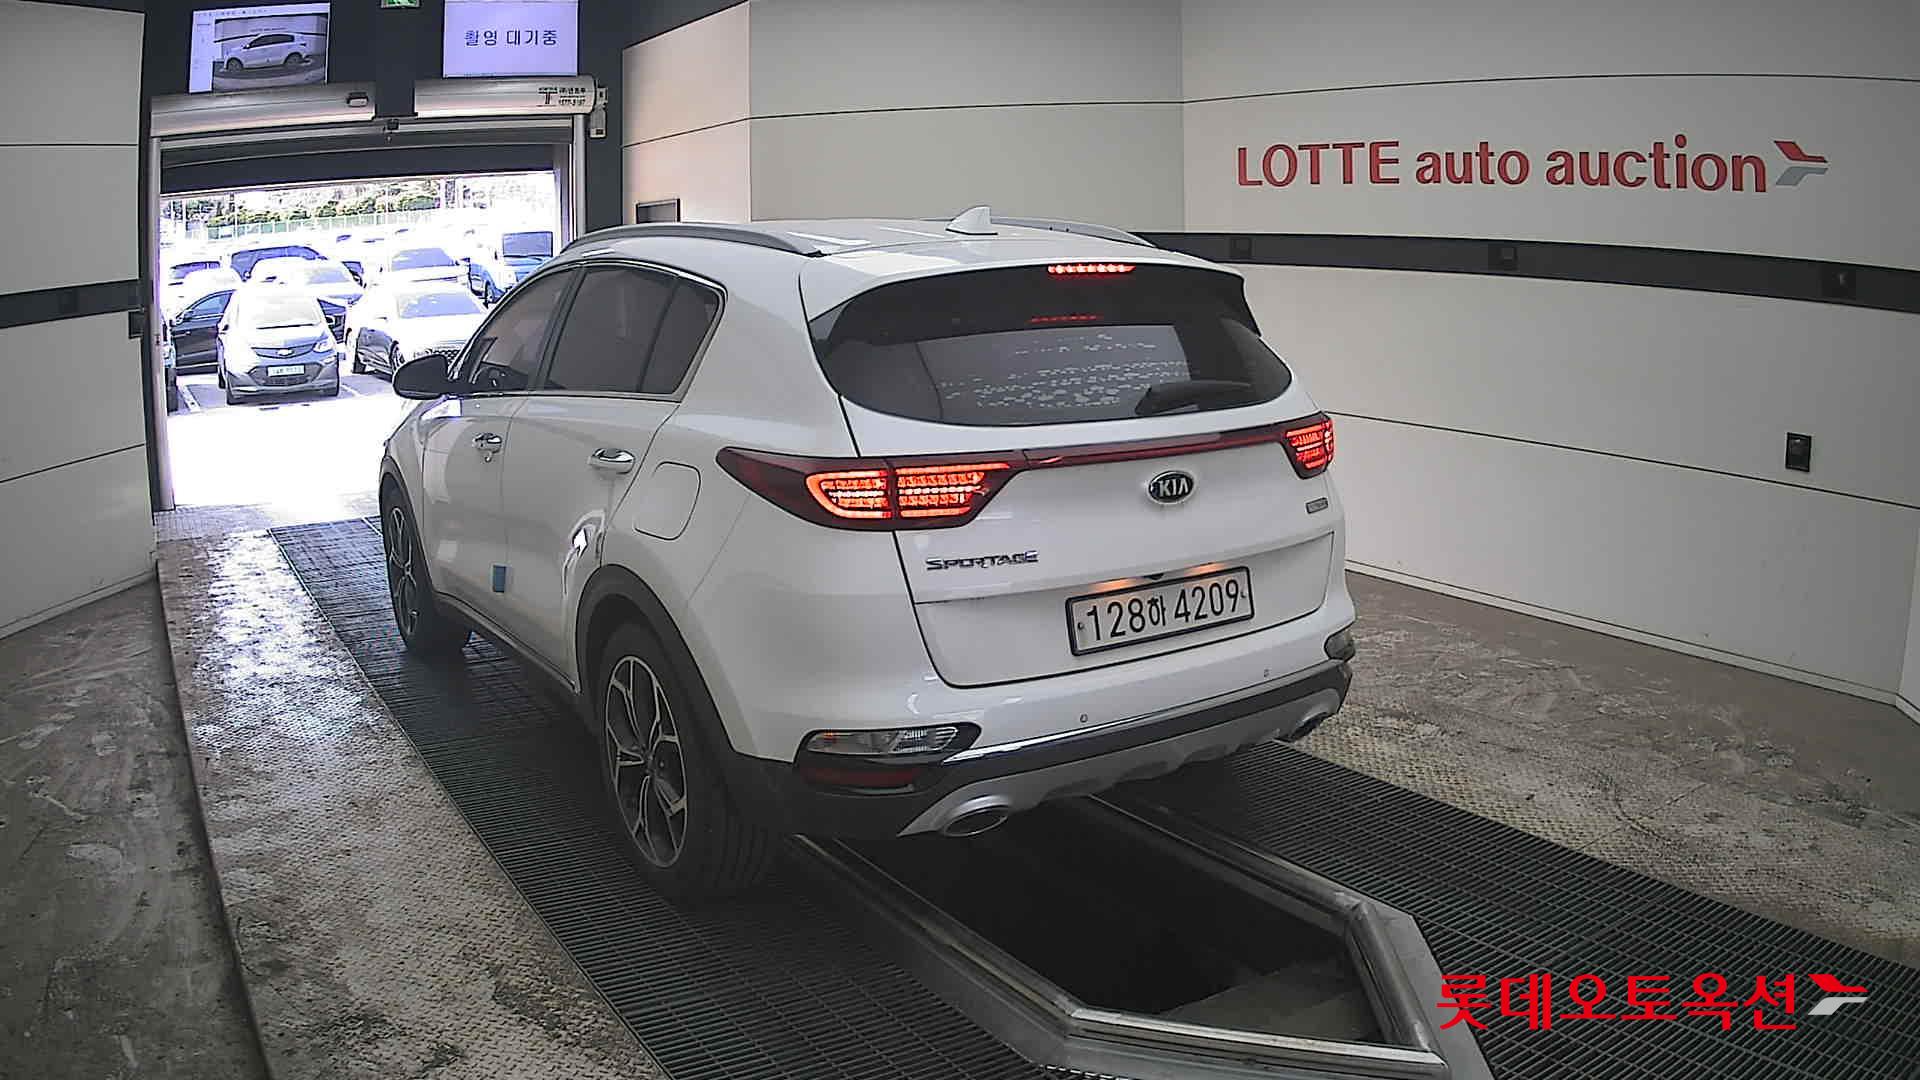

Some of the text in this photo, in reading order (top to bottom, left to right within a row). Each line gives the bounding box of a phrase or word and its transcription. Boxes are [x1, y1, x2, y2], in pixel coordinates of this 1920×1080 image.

[506, 29, 558, 46] 대기중
[1237, 134, 1768, 193] LOTTE auto auction
[1157, 477, 1189, 497] KIA
[925, 550, 1039, 571] SPORTAGE
[1174, 579, 1240, 624] 4209
